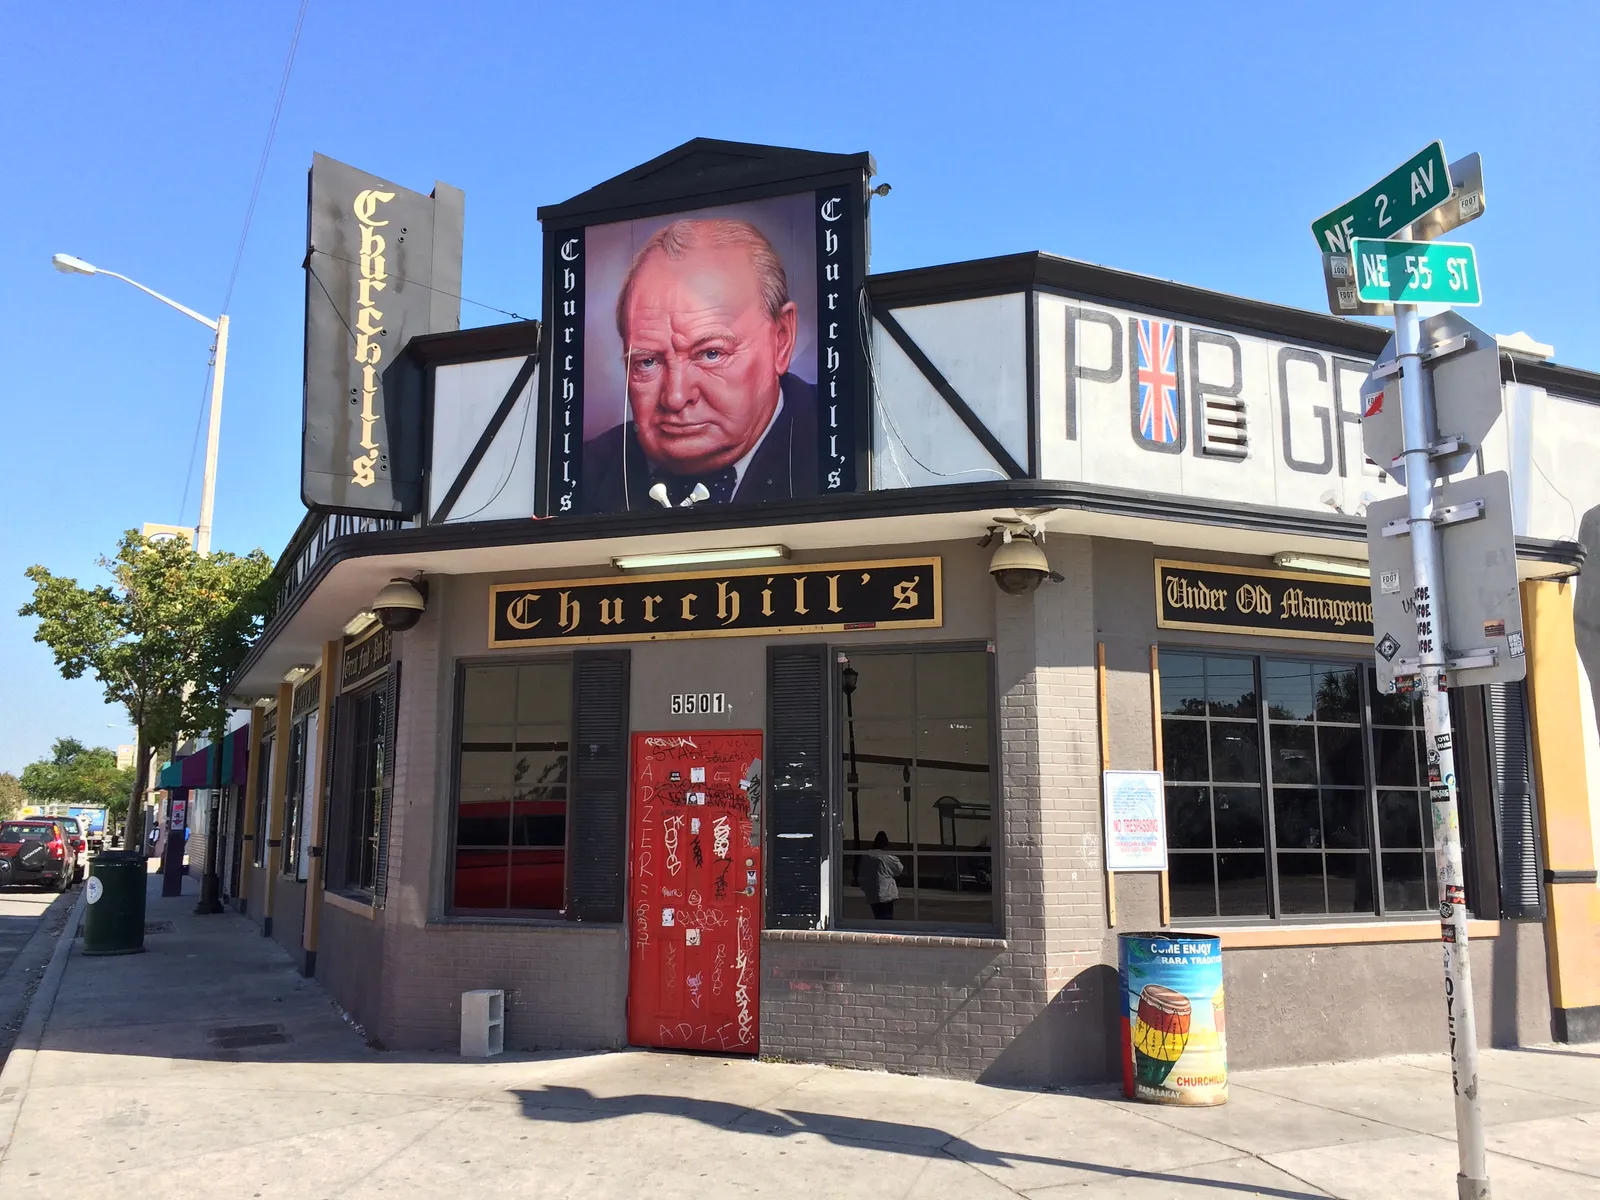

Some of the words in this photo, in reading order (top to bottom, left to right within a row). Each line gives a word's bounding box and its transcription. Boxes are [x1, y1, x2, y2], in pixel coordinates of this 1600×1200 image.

[1324, 215, 1354, 252] NE
[1374, 194, 1392, 228] 2
[1411, 159, 1434, 206] AV
[1362, 253, 1391, 287] NE
[1405, 256, 1432, 290] 55
[1446, 257, 1469, 291] ST
[353, 189, 395, 487] Churchill's
[821, 198, 845, 489] Churchill's
[560, 238, 579, 511] Churchill's
[1065, 304, 1246, 464] PUB
[506, 573, 920, 634] Churchill's
[1166, 575, 1228, 612] Under
[1236, 583, 1272, 615] Old
[671, 694, 724, 714] 5501
[1113, 819, 1121, 832] NO
[1160, 956, 1189, 965] RARA
[1183, 943, 1211, 956] ENJOY
[659, 1022, 743, 1051] ADZE
